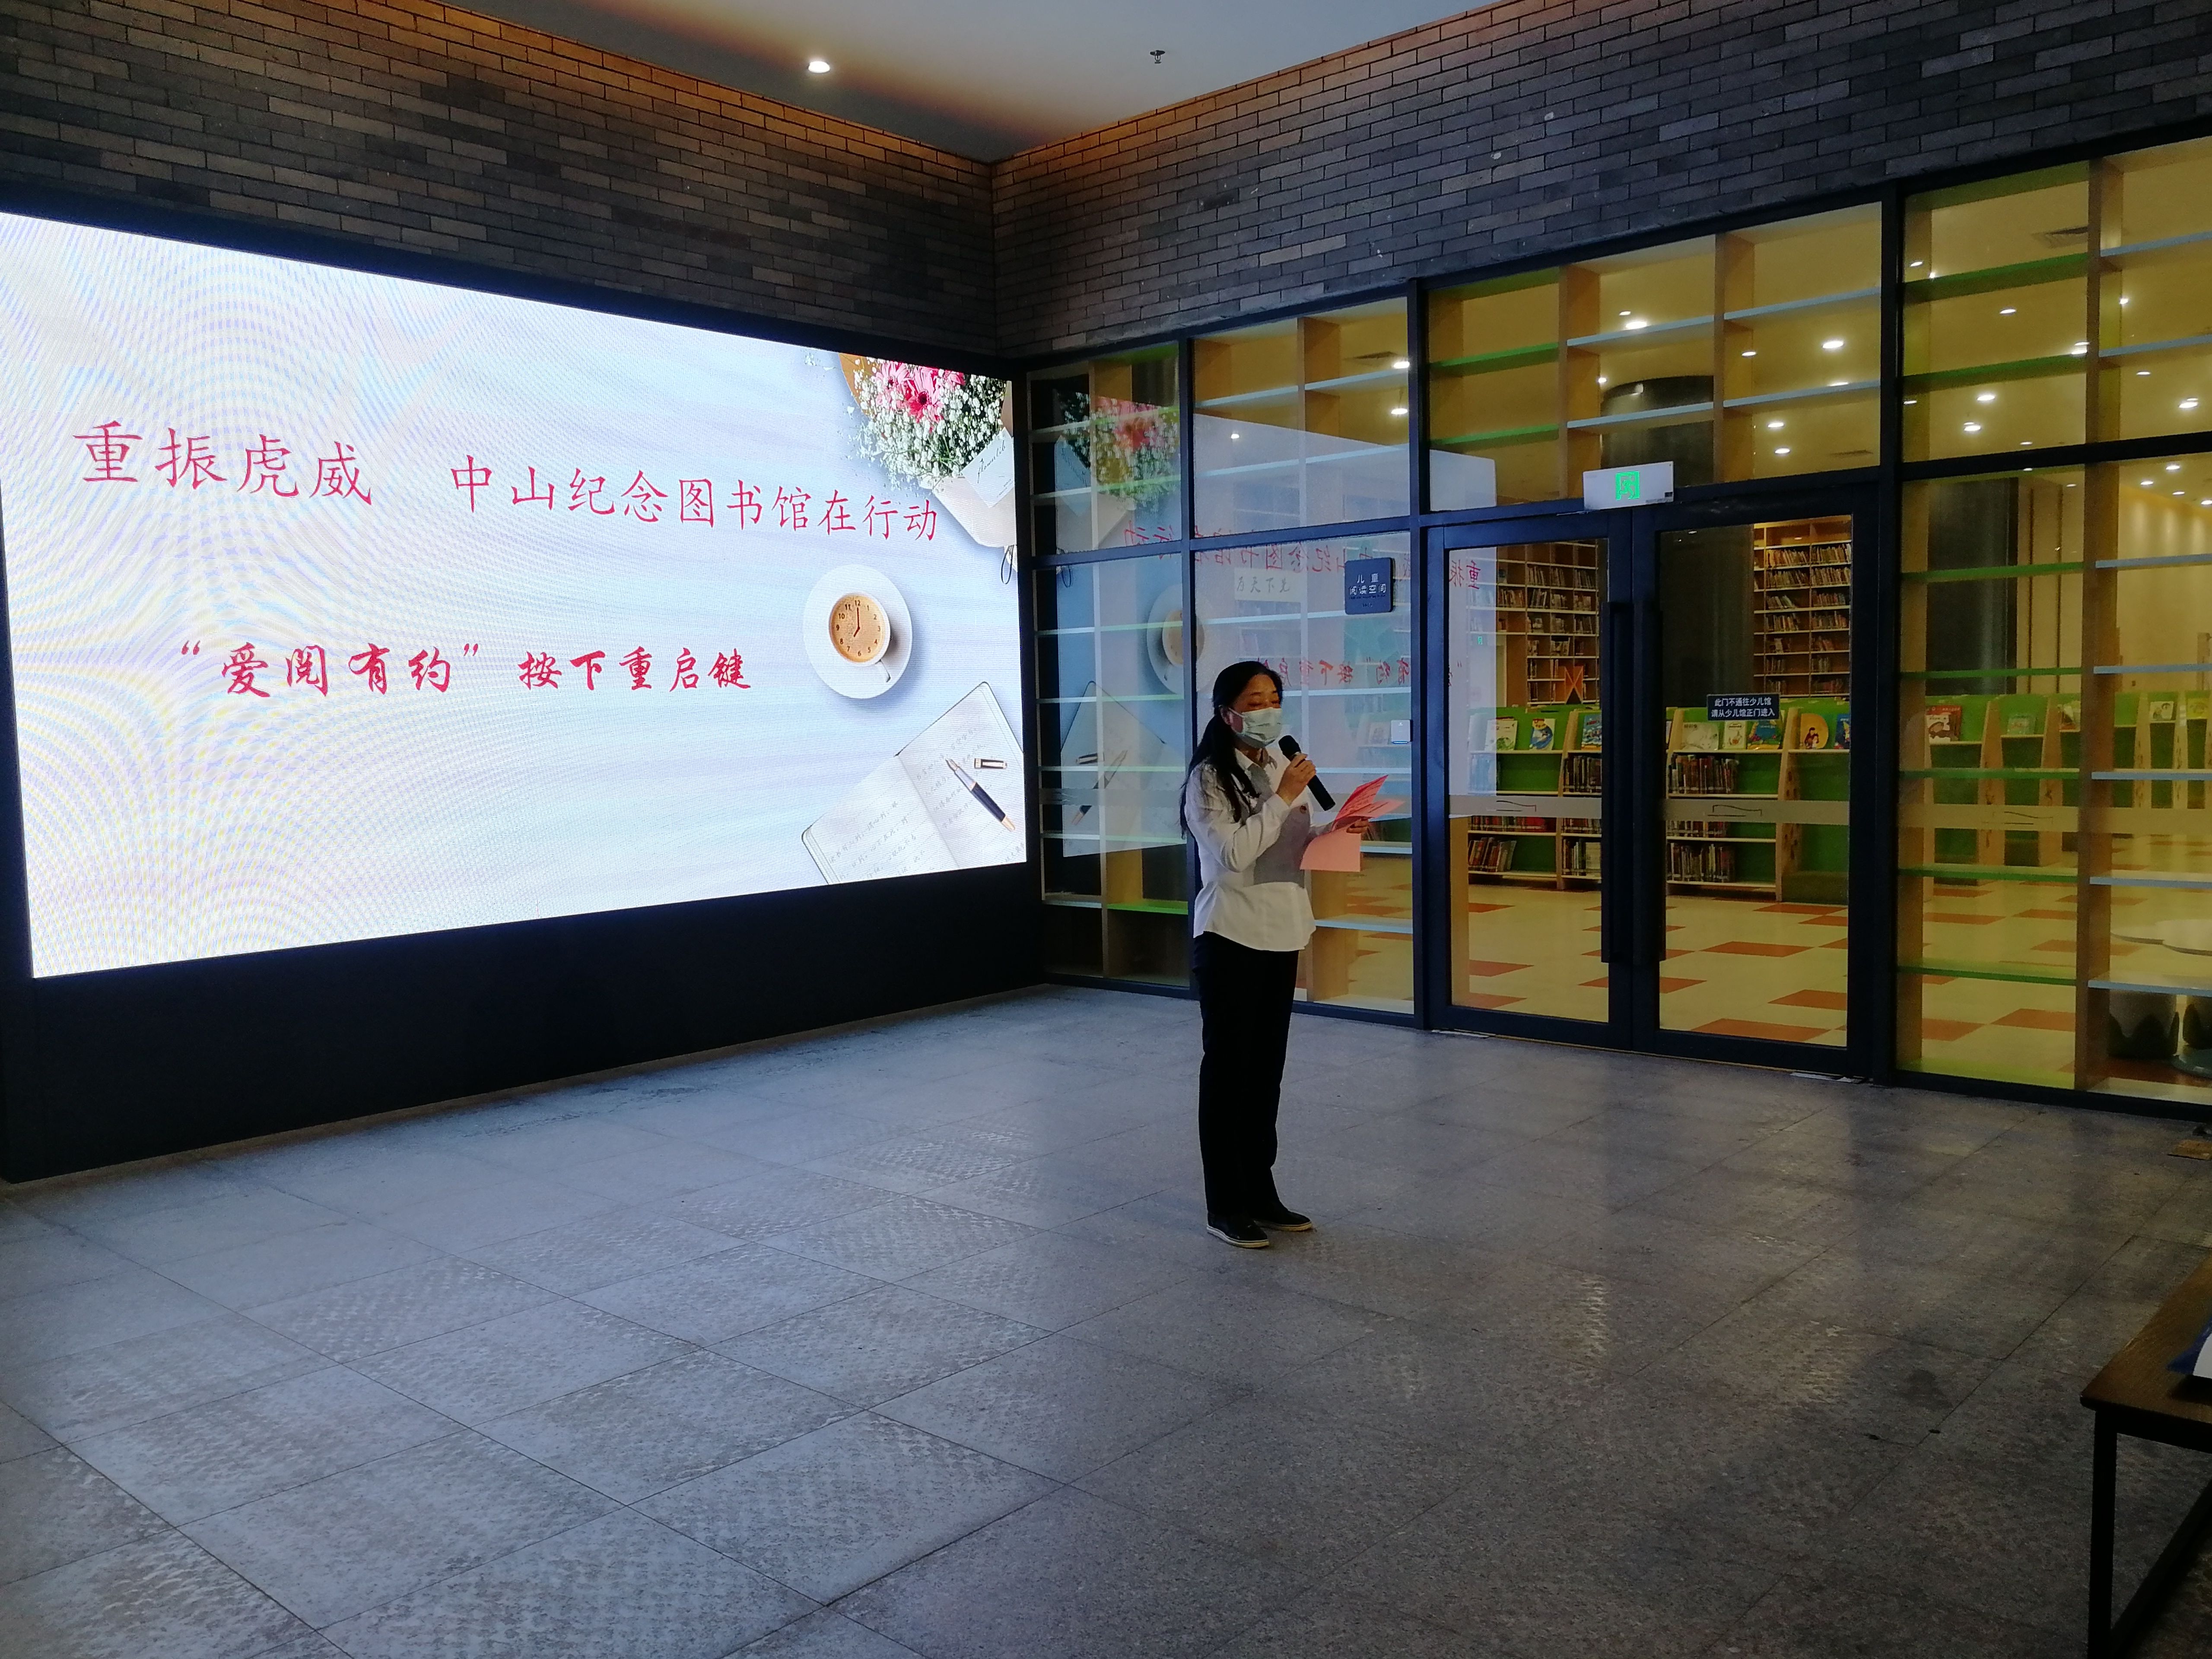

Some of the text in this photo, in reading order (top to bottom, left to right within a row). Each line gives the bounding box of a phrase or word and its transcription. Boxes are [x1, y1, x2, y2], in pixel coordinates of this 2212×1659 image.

[73, 420, 937, 541] 重振虎威 中山纪念图书馆在行动
[1349, 584, 1386, 595] 阅读空间
[518, 647, 751, 691] 按下重启键
[1714, 697, 1772, 707] 此门不通往少儿馆
[1711, 708, 1775, 718] 请从少儿馆正门进入
